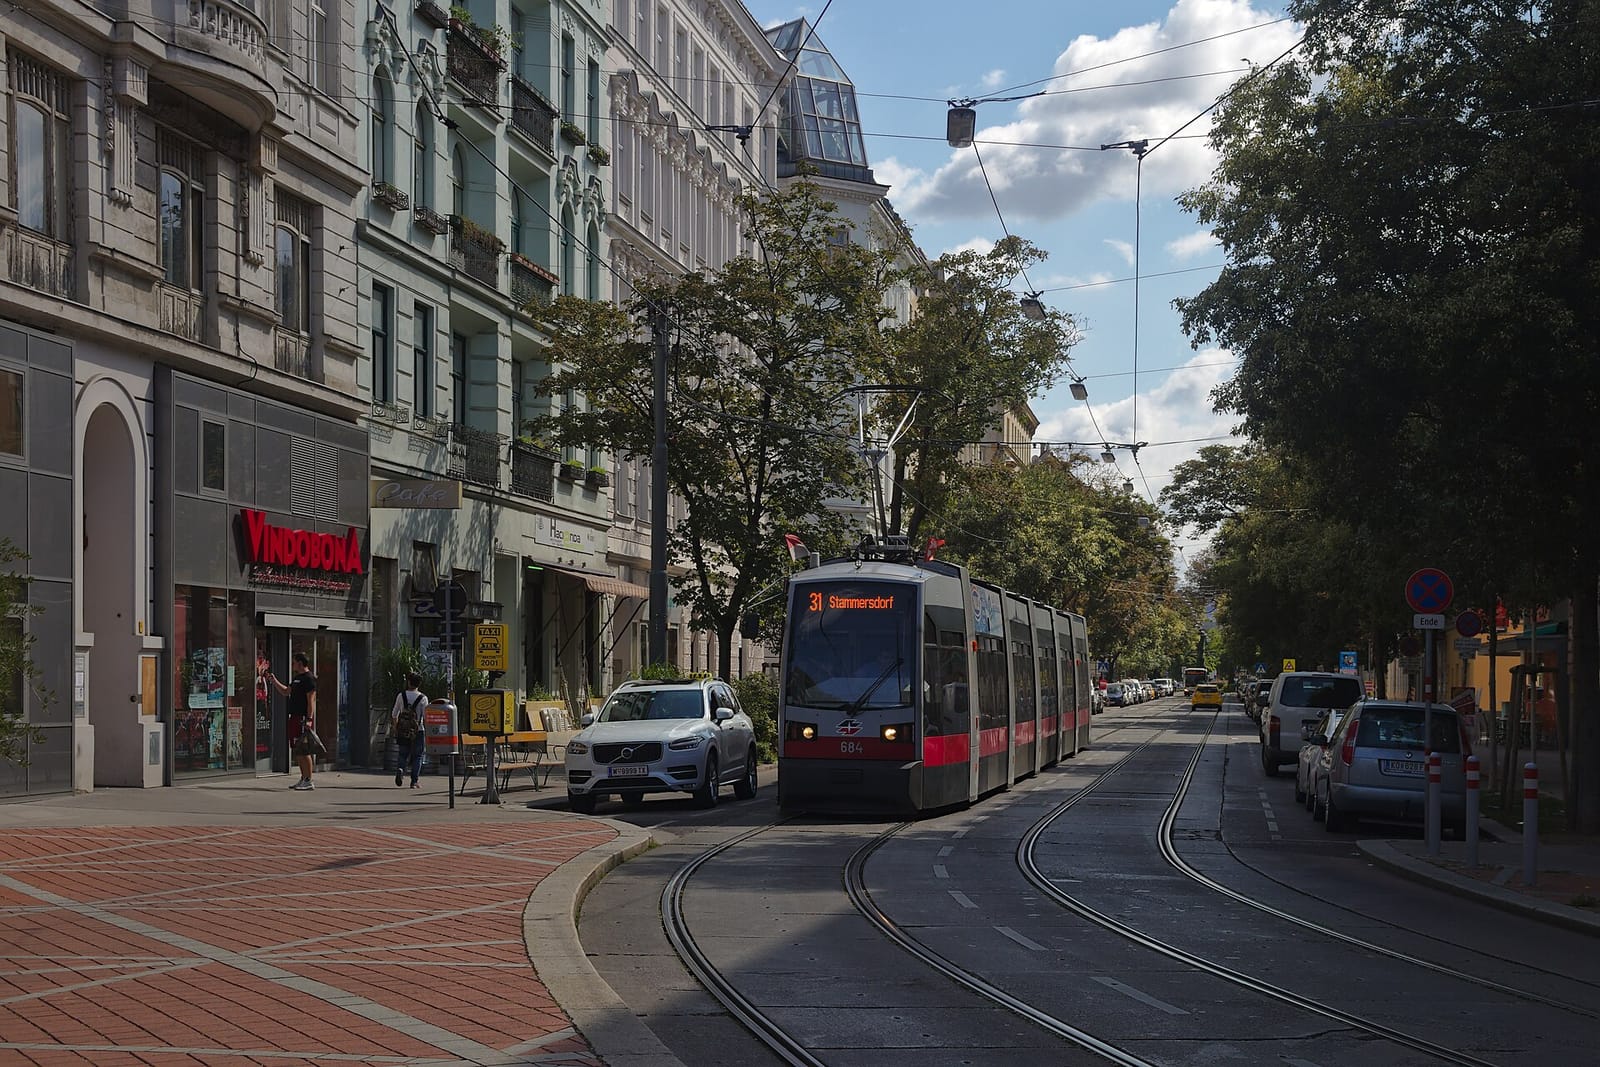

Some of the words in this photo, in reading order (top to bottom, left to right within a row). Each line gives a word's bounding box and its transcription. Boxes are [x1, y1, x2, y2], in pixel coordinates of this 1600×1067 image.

[808, 592, 822, 611] 31
[829, 595, 894, 609] Stammersdorf
[1420, 616, 1439, 627] Ende
[480, 628, 500, 636] TAXI
[480, 659, 498, 667] 2001
[840, 740, 864, 754] 684
